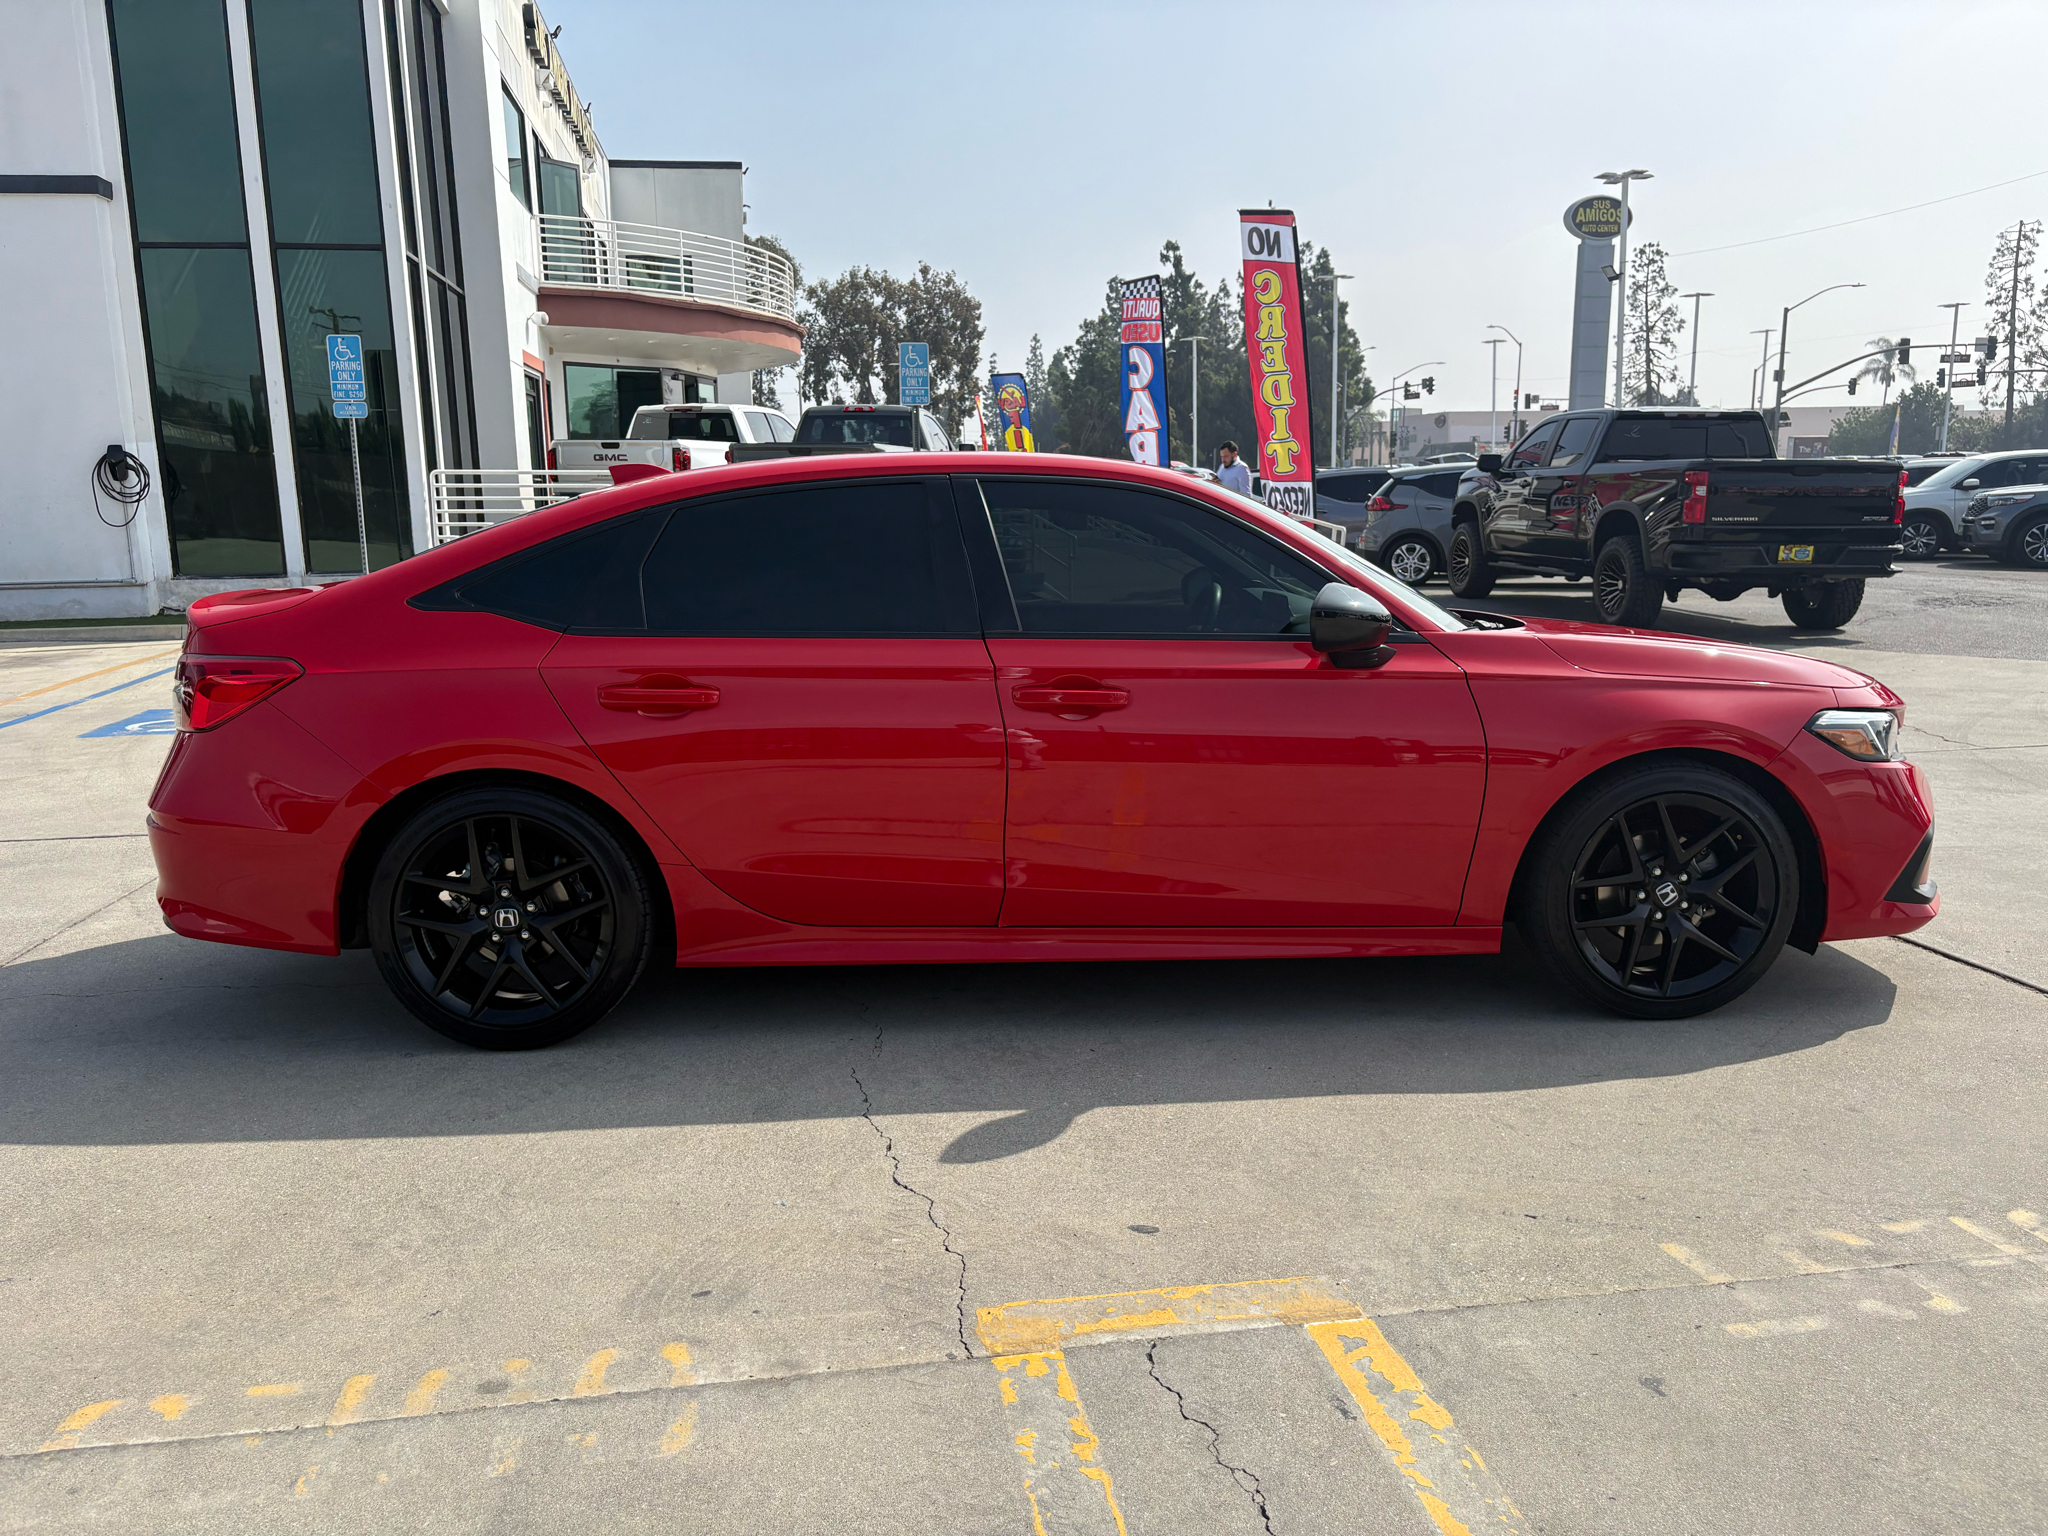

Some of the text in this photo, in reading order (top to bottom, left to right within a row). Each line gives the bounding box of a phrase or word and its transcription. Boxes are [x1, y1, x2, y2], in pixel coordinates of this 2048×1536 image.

[1593, 200, 1611, 209] SUS
[1576, 208, 1622, 223] AMIGOS
[331, 360, 360, 370] PARKING
[338, 371, 356, 380] ONLY
[902, 368, 928, 376] PARKING
[906, 378, 922, 386] ONLY
